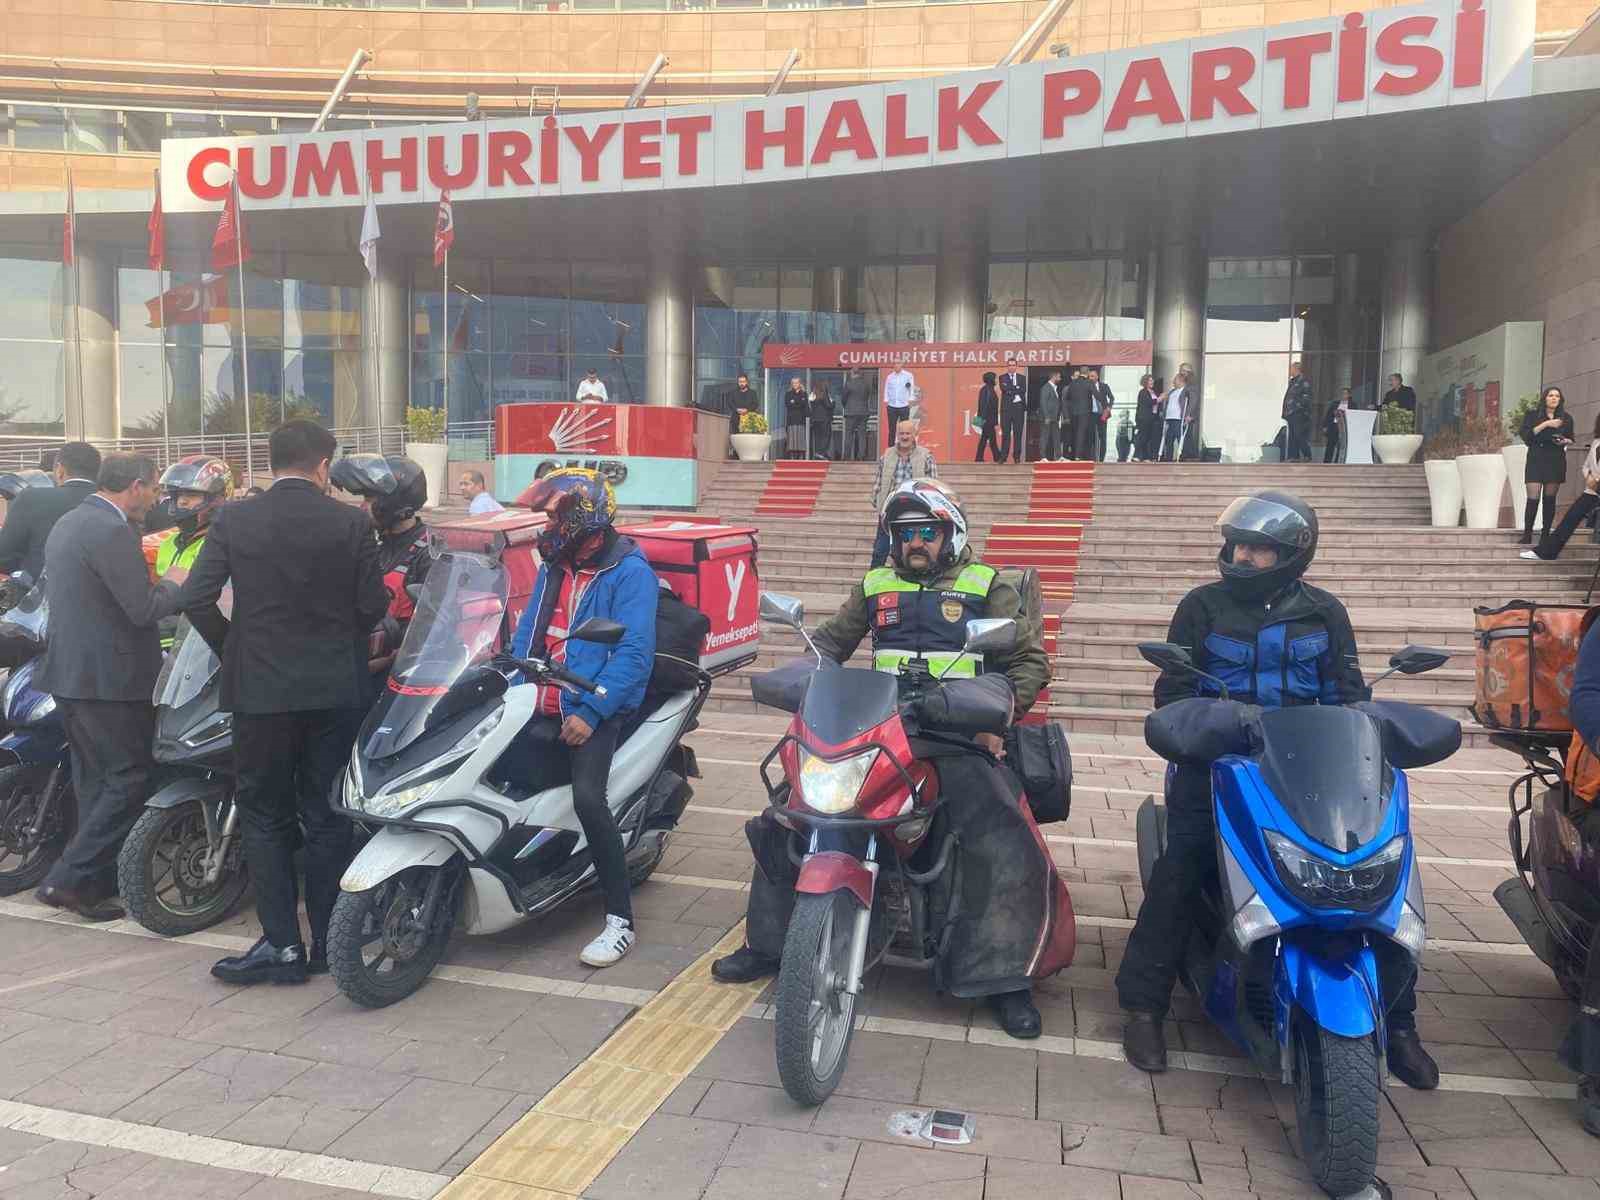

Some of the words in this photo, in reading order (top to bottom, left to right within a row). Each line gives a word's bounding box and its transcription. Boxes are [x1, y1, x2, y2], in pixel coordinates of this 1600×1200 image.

[186, 114, 712, 201] CUMHURİYET
[745, 80, 1003, 169] HALK
[1041, 0, 1485, 138] PARTİSİ
[838, 347, 947, 364] CUMHURİYET
[953, 350, 997, 363] HALK
[1004, 345, 1071, 363] PARTİSİ
[705, 620, 759, 652] Yemeksepeti
